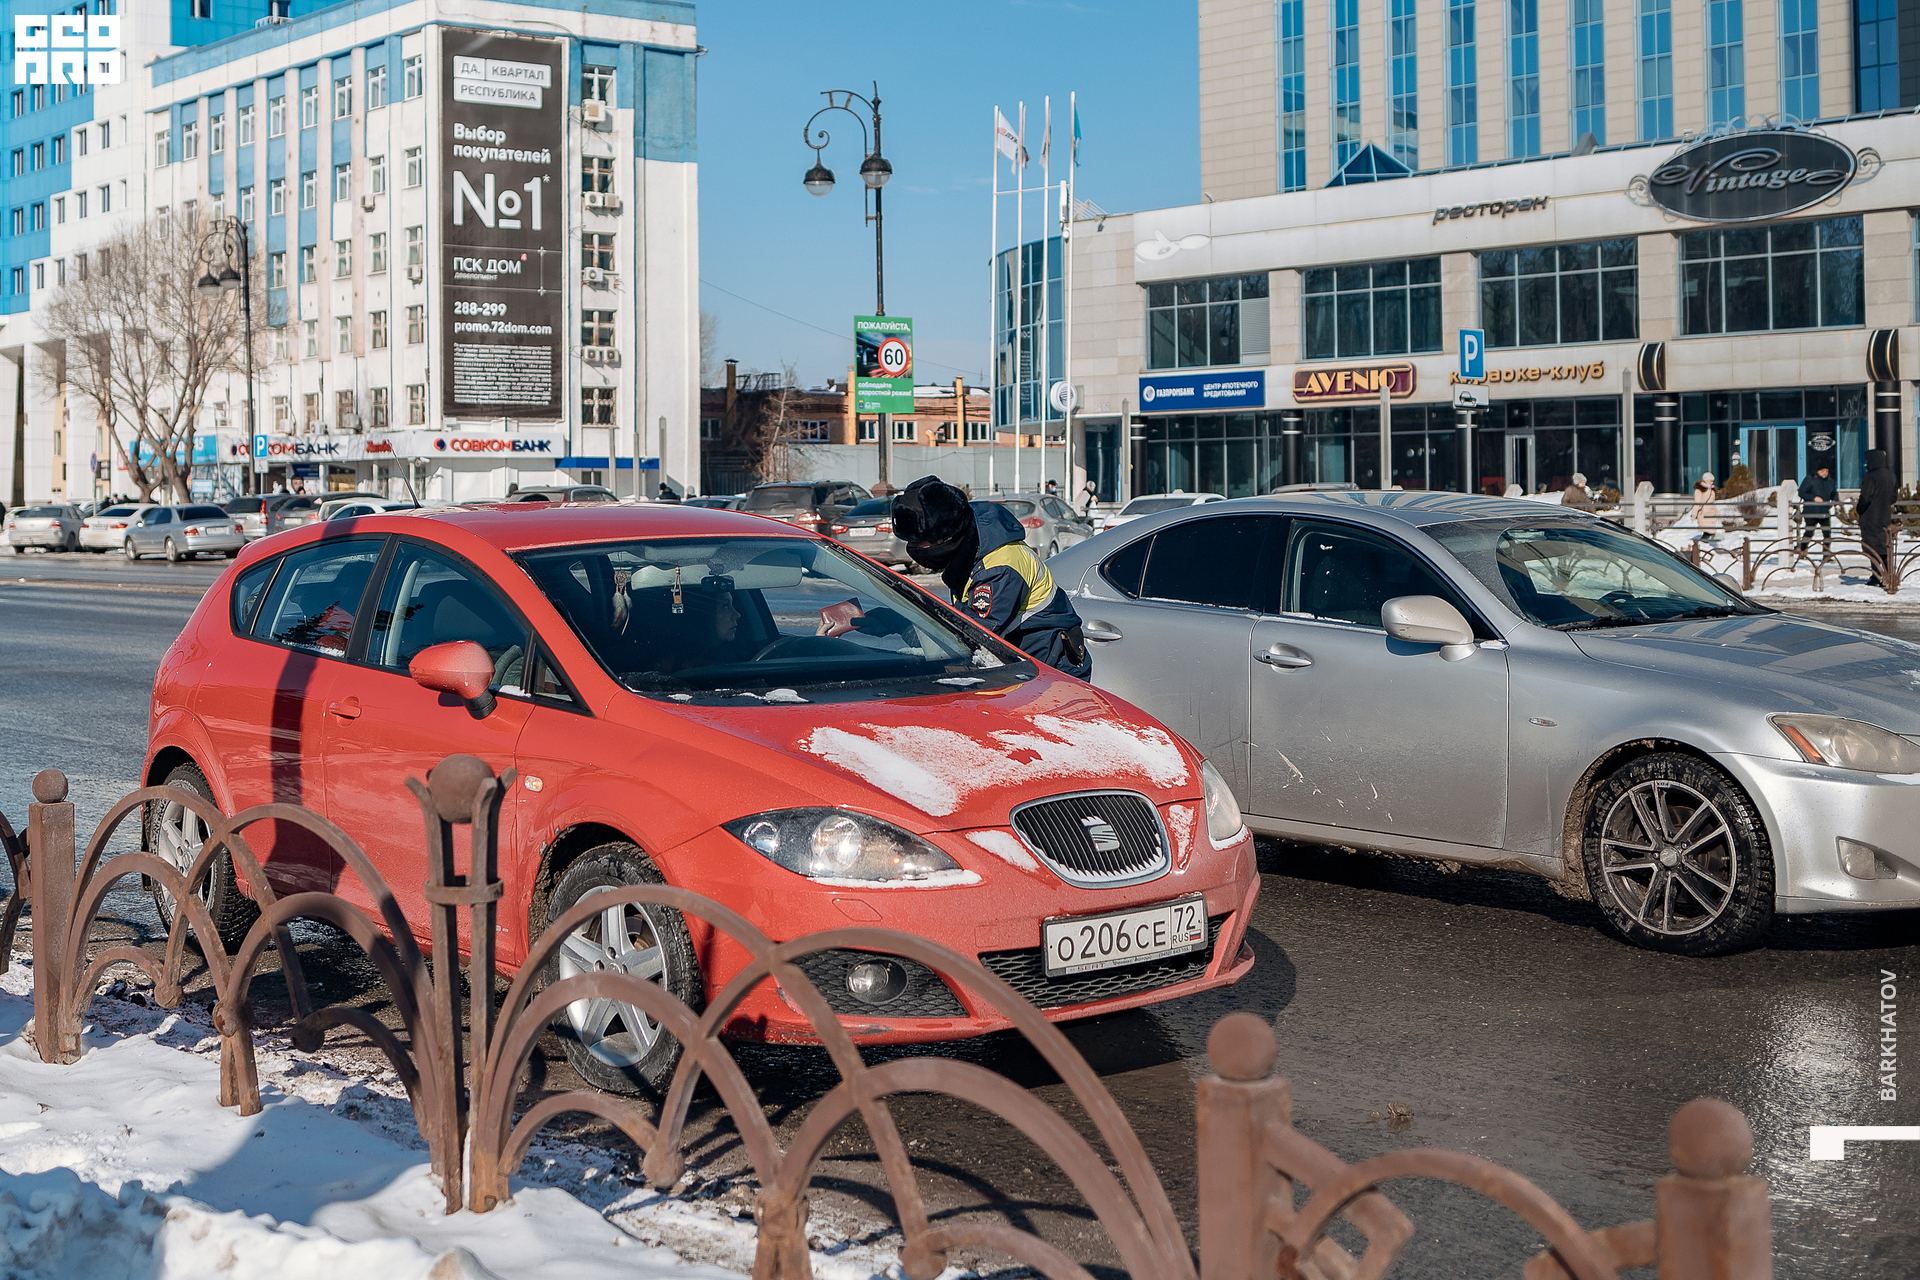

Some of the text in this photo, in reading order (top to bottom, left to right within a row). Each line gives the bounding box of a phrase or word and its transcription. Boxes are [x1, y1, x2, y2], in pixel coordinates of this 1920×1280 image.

[461, 62, 544, 80] ДА. КВАРТАЛ
[460, 84, 537, 101] РЕСПУБЛИКА
[453, 122, 507, 147] Выбор
[453, 144, 551, 165] покупателей
[1652, 147, 1847, 195] Vintage
[1432, 196, 1549, 226] ресторан
[453, 256, 522, 275] ПСК ДОМ
[454, 301, 507, 317] 288-299
[454, 320, 553, 336] promo.72dom.com
[857, 321, 911, 332] ПОЖАЛУЙСТА,
[884, 348, 904, 366] 60
[1203, 380, 1259, 391] ЦЕНТР ИПОТЕЧНОГО
[1303, 369, 1396, 394] AVENIO
[1156, 387, 1195, 398] ГАЗПРОМБАНК
[1203, 389, 1247, 399] КРЕДИТОВАНИЯ
[238, 442, 339, 455] СООМБАНК
[450, 438, 551, 453] СОВКОМБАНК
[1173, 905, 1196, 933] 72
[1172, 932, 1190, 944] RUS
